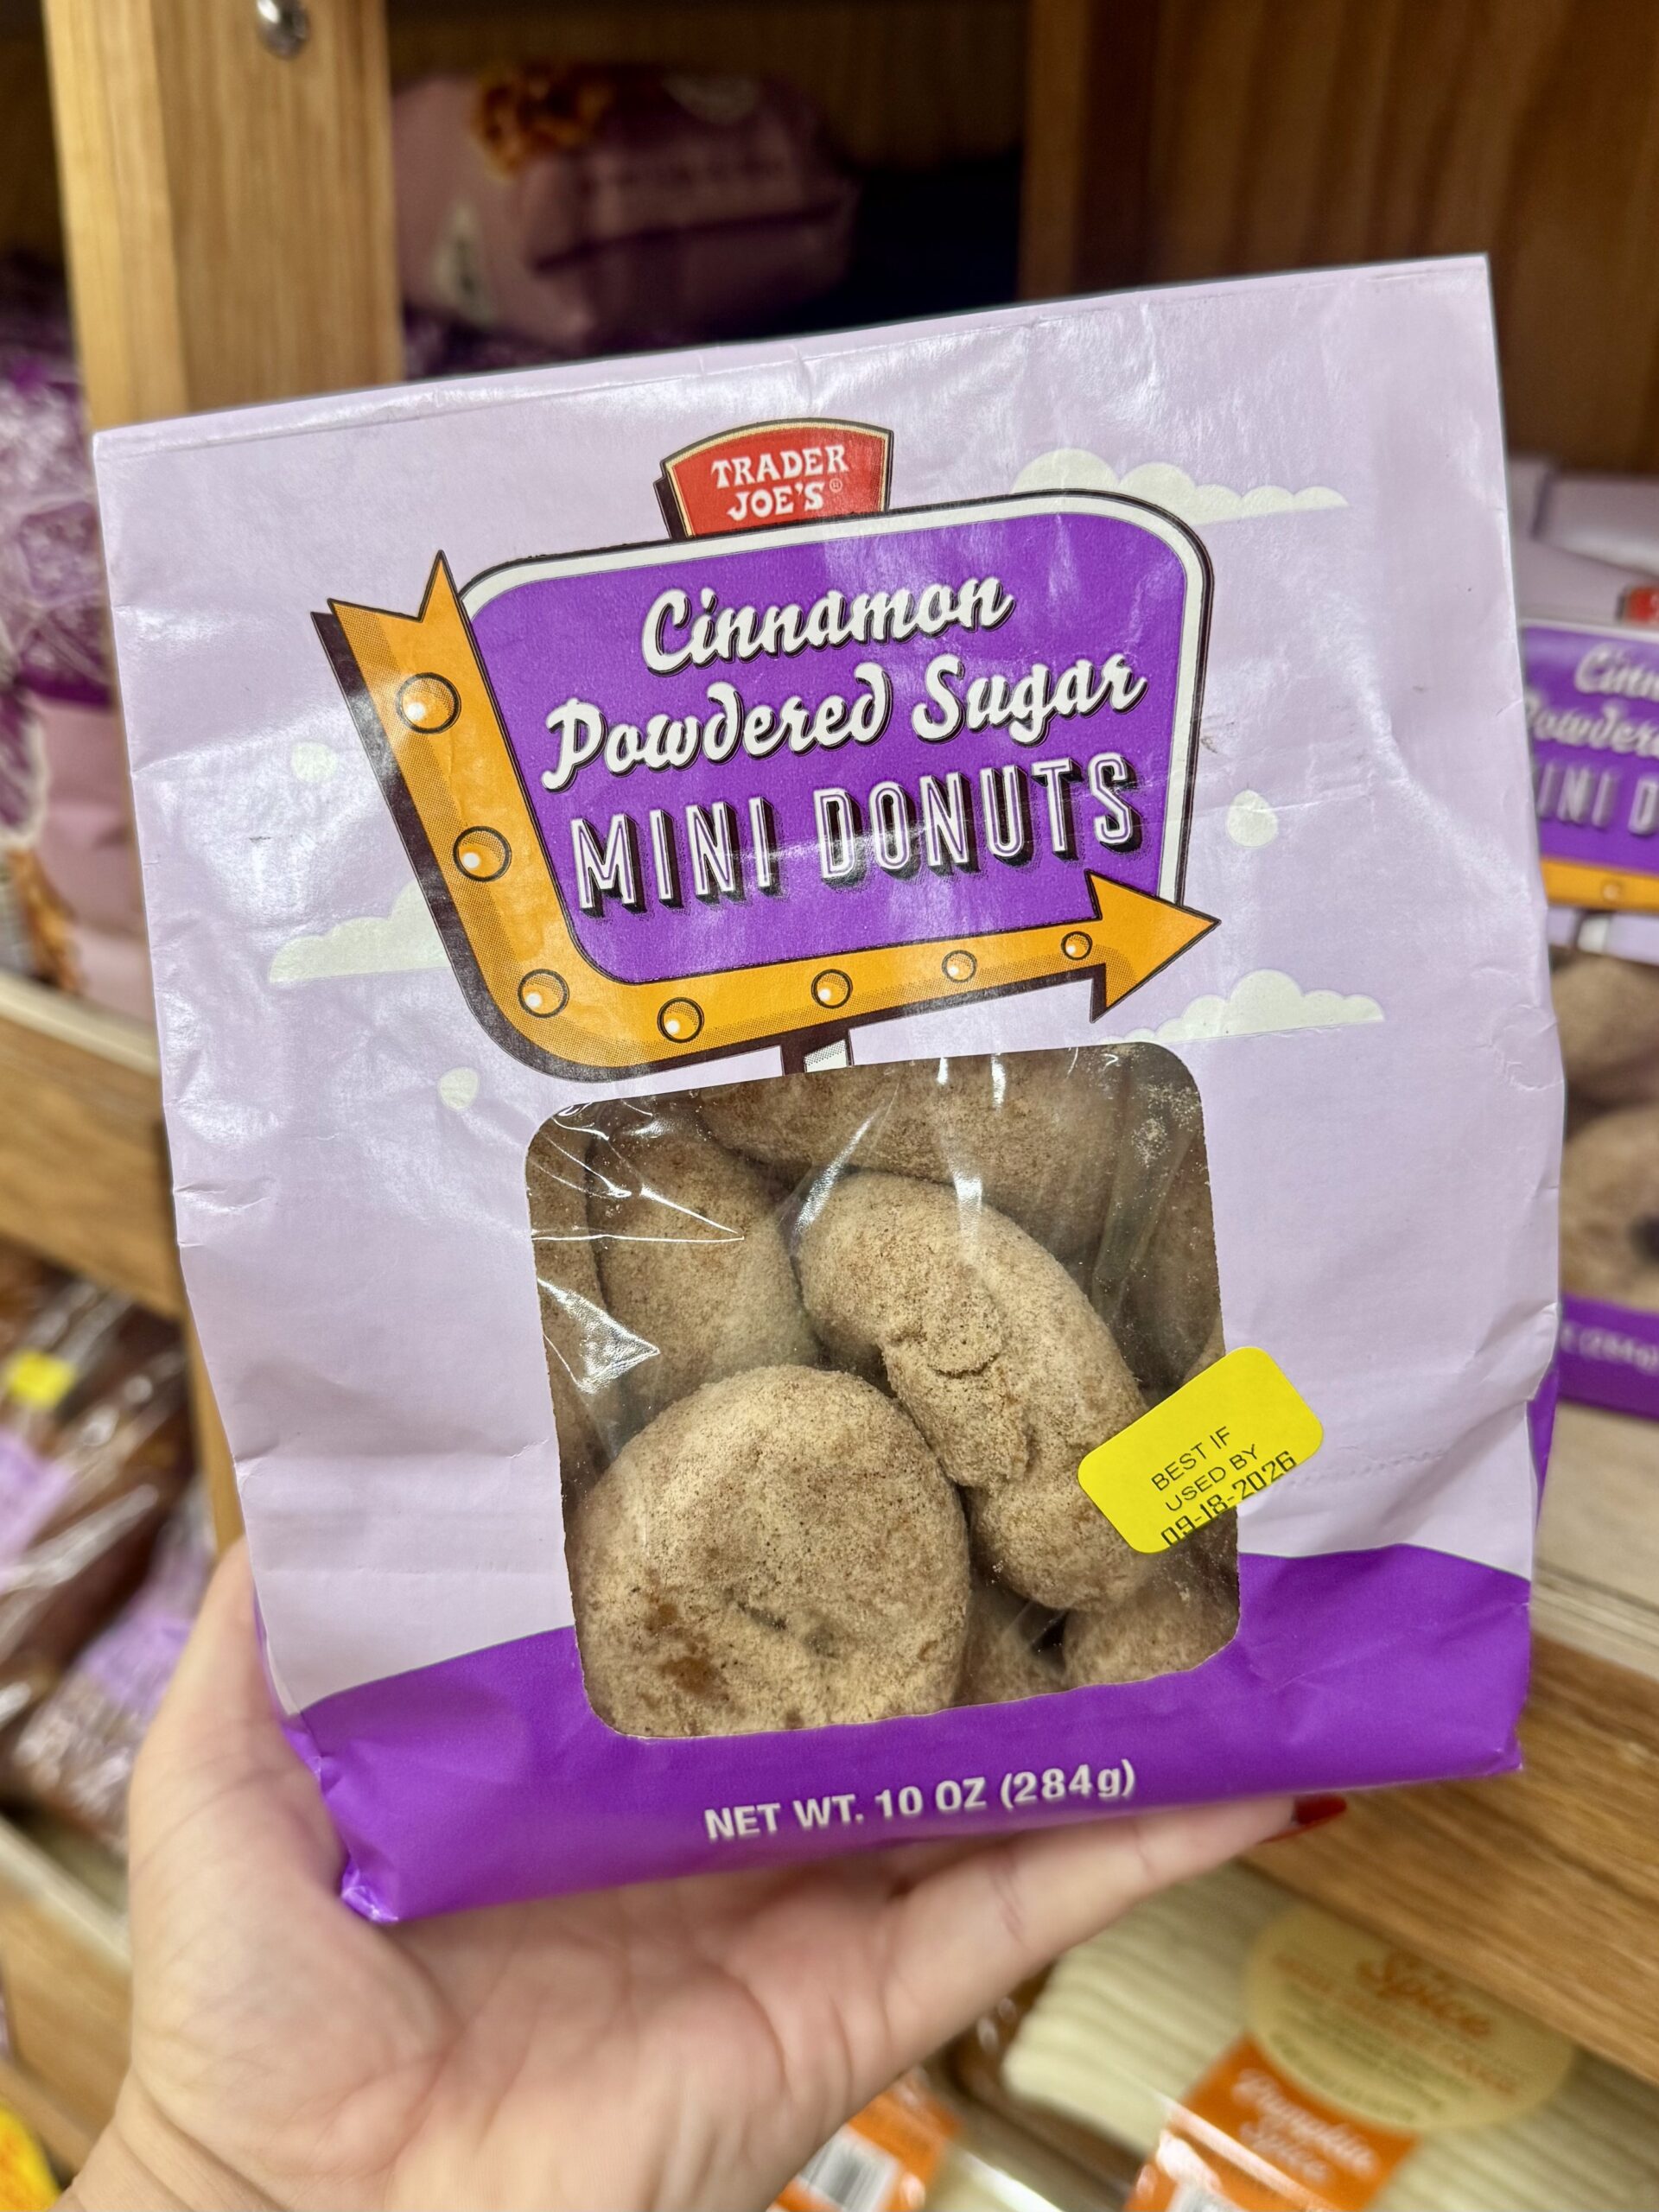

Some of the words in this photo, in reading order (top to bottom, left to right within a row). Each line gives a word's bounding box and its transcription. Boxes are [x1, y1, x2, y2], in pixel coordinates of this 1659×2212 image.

[710, 444, 849, 489] TRADER
[642, 575, 1014, 675] Cinnamon
[542, 663, 892, 791] Powdered
[912, 653, 1149, 746] Sugar
[571, 796, 782, 912] MINI
[813, 752, 1139, 881] DONUTS
[1152, 1442, 1207, 1491] BEST
[1210, 1426, 1230, 1450] IF
[1160, 1451, 1296, 1547] 09-18-2026
[1165, 1466, 1226, 1512] USED
[1229, 1444, 1259, 1471] BY
[704, 1802, 780, 1840] NET
[794, 1793, 864, 1831] WT.
[874, 1786, 924, 1818] 10
[936, 1777, 988, 1812] OZ
[1000, 1759, 1136, 1808] (284g)
